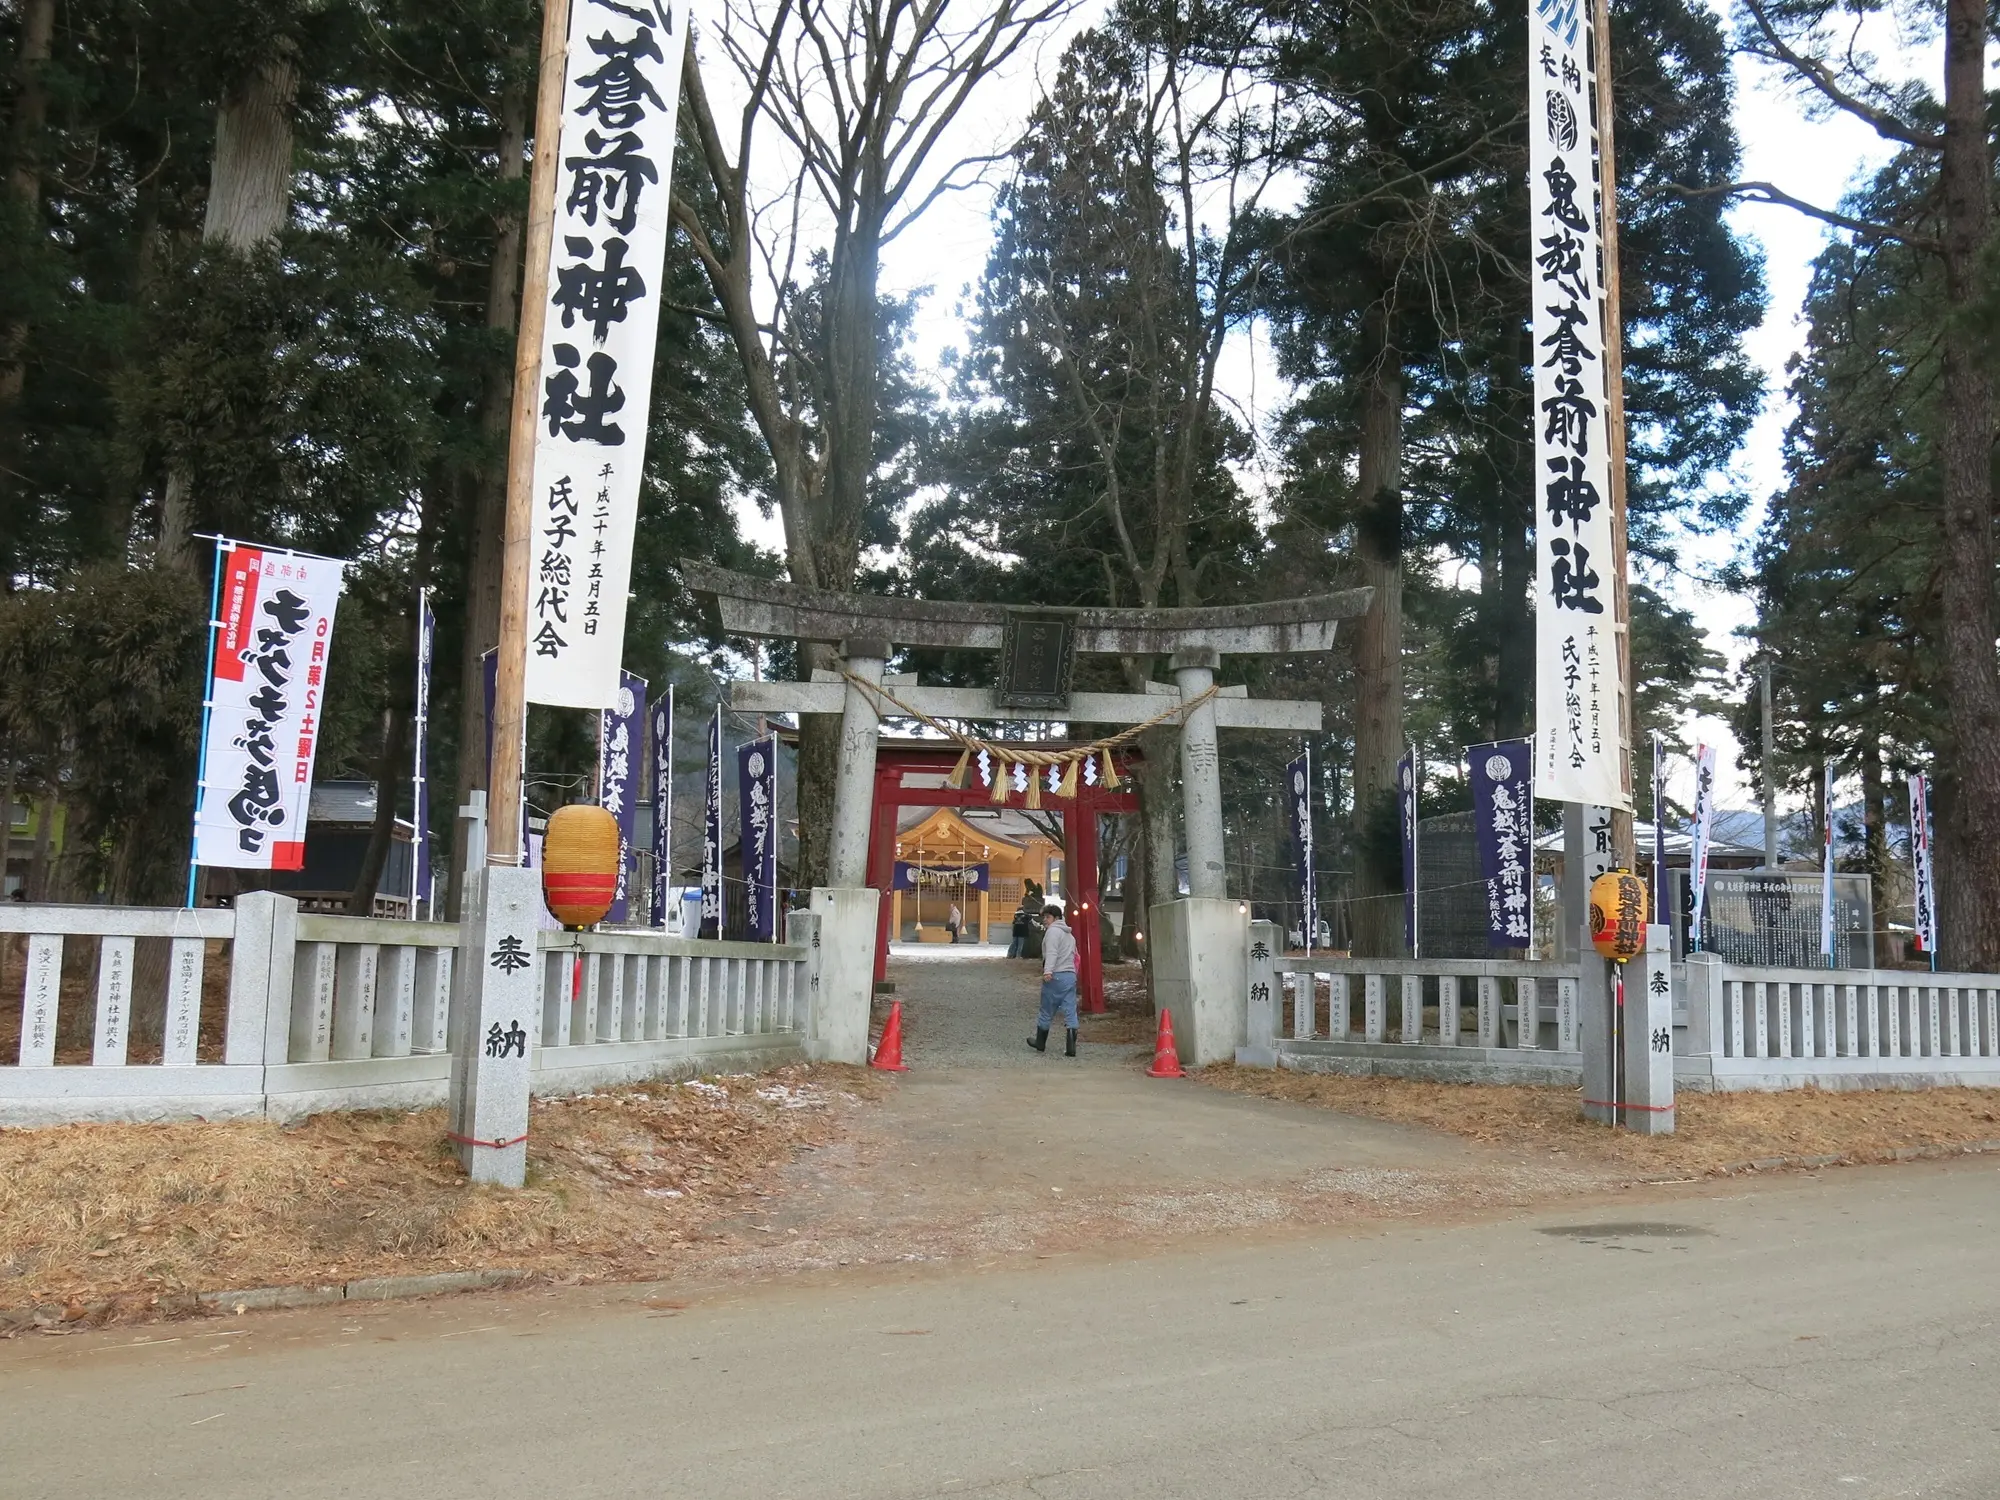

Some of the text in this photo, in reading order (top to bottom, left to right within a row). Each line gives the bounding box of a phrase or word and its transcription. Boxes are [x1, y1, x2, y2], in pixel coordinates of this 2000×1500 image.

[532, 475, 579, 658] 氏子総代会
[583, 462, 614, 636] 平成二十年五月五日
[1562, 635, 1586, 770] 氏子総代会
[1586, 625, 1601, 754] 平成二十年五月五日
[1491, 784, 1529, 938] 鬼越蒼前神社
[1514, 780, 1530, 845] チャグチャグ馬コ
[1487, 878, 1503, 932] 氏子総代会
[486, 934, 530, 1060] 奉納
[1250, 941, 1270, 1002] 奉納
[1650, 970, 1670, 1053] 奉納
